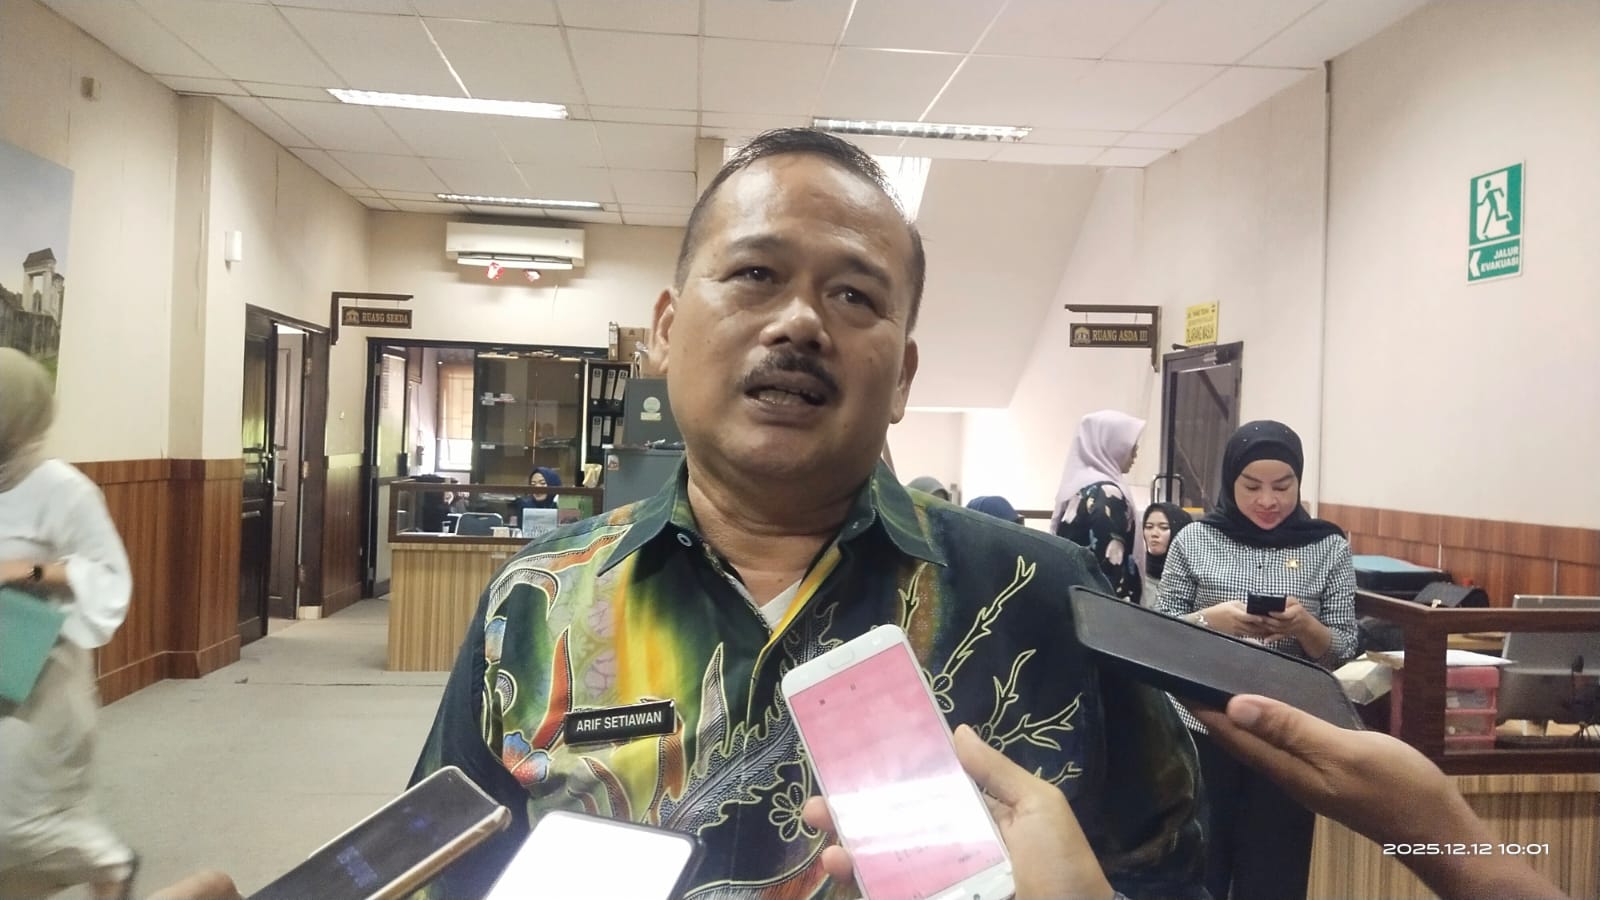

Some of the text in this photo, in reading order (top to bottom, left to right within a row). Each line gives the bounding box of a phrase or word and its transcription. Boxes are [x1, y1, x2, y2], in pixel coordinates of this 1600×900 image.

[1493, 246, 1519, 260] JALUR
[1480, 256, 1519, 272] EVAKUASI
[1091, 329, 1118, 342] RUANG
[576, 711, 662, 732] ARIF SETIAWAN
